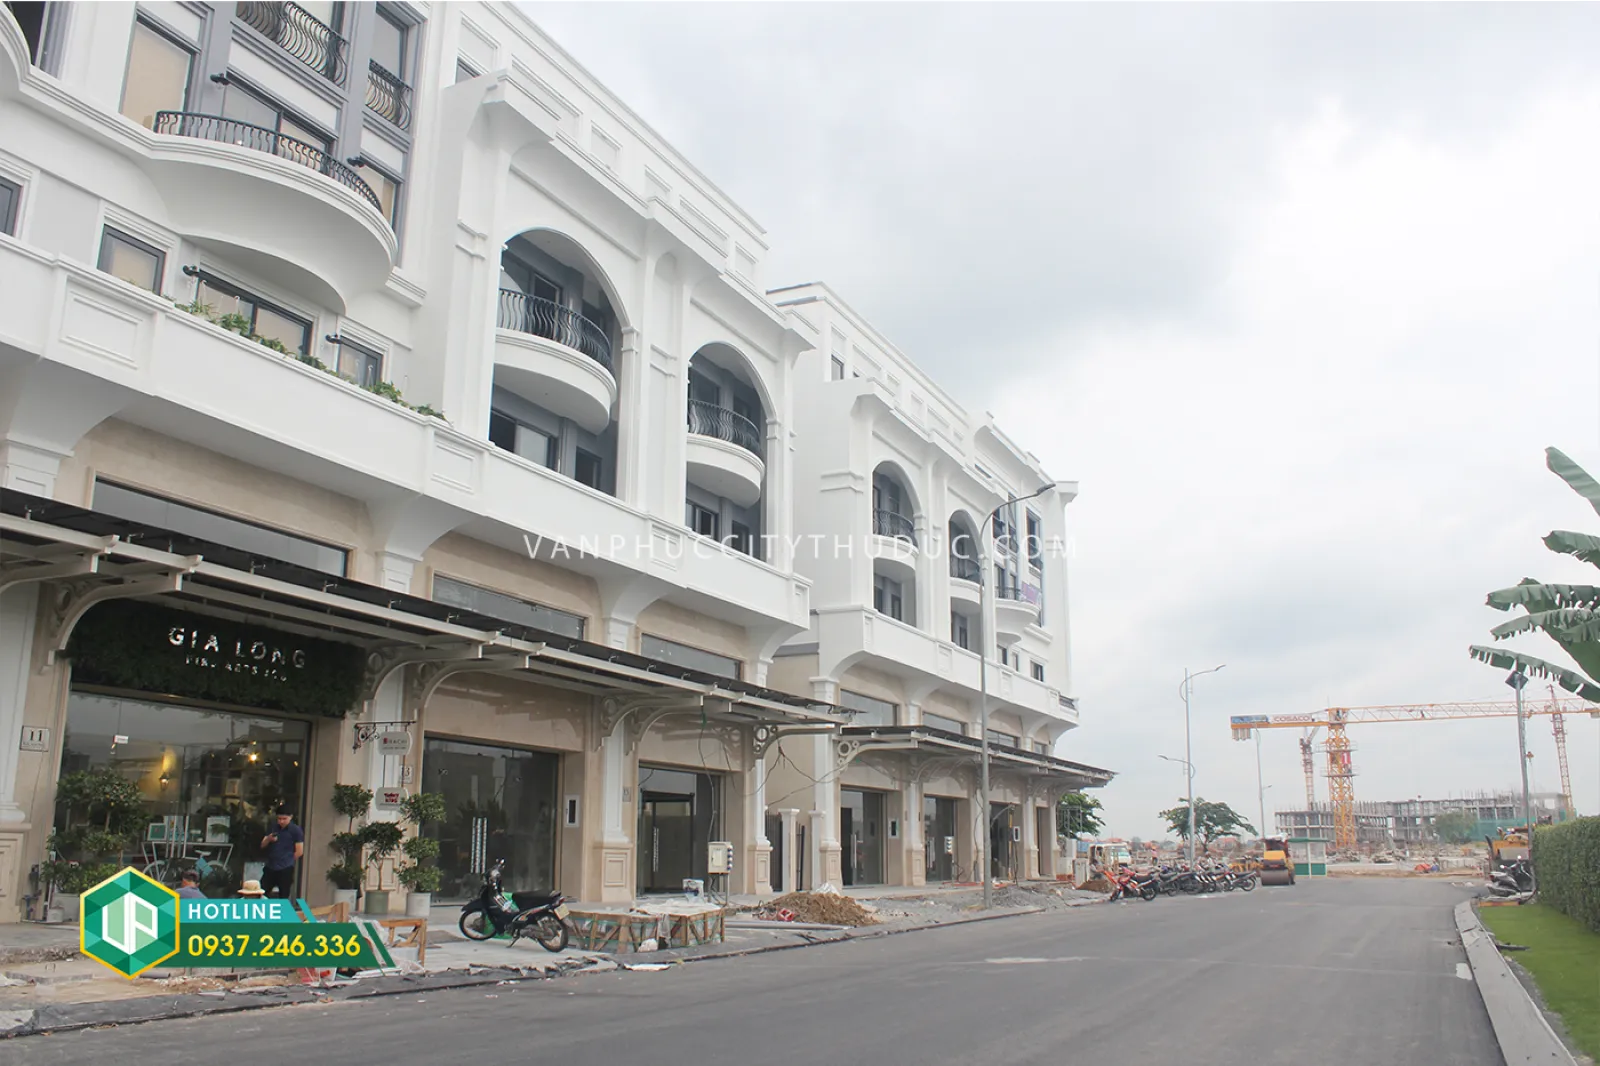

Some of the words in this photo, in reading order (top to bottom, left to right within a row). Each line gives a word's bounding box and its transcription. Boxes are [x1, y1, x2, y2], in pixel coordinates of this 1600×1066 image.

[168, 627, 219, 653] GIA
[234, 639, 306, 669] LONG
[30, 730, 43, 742] 11
